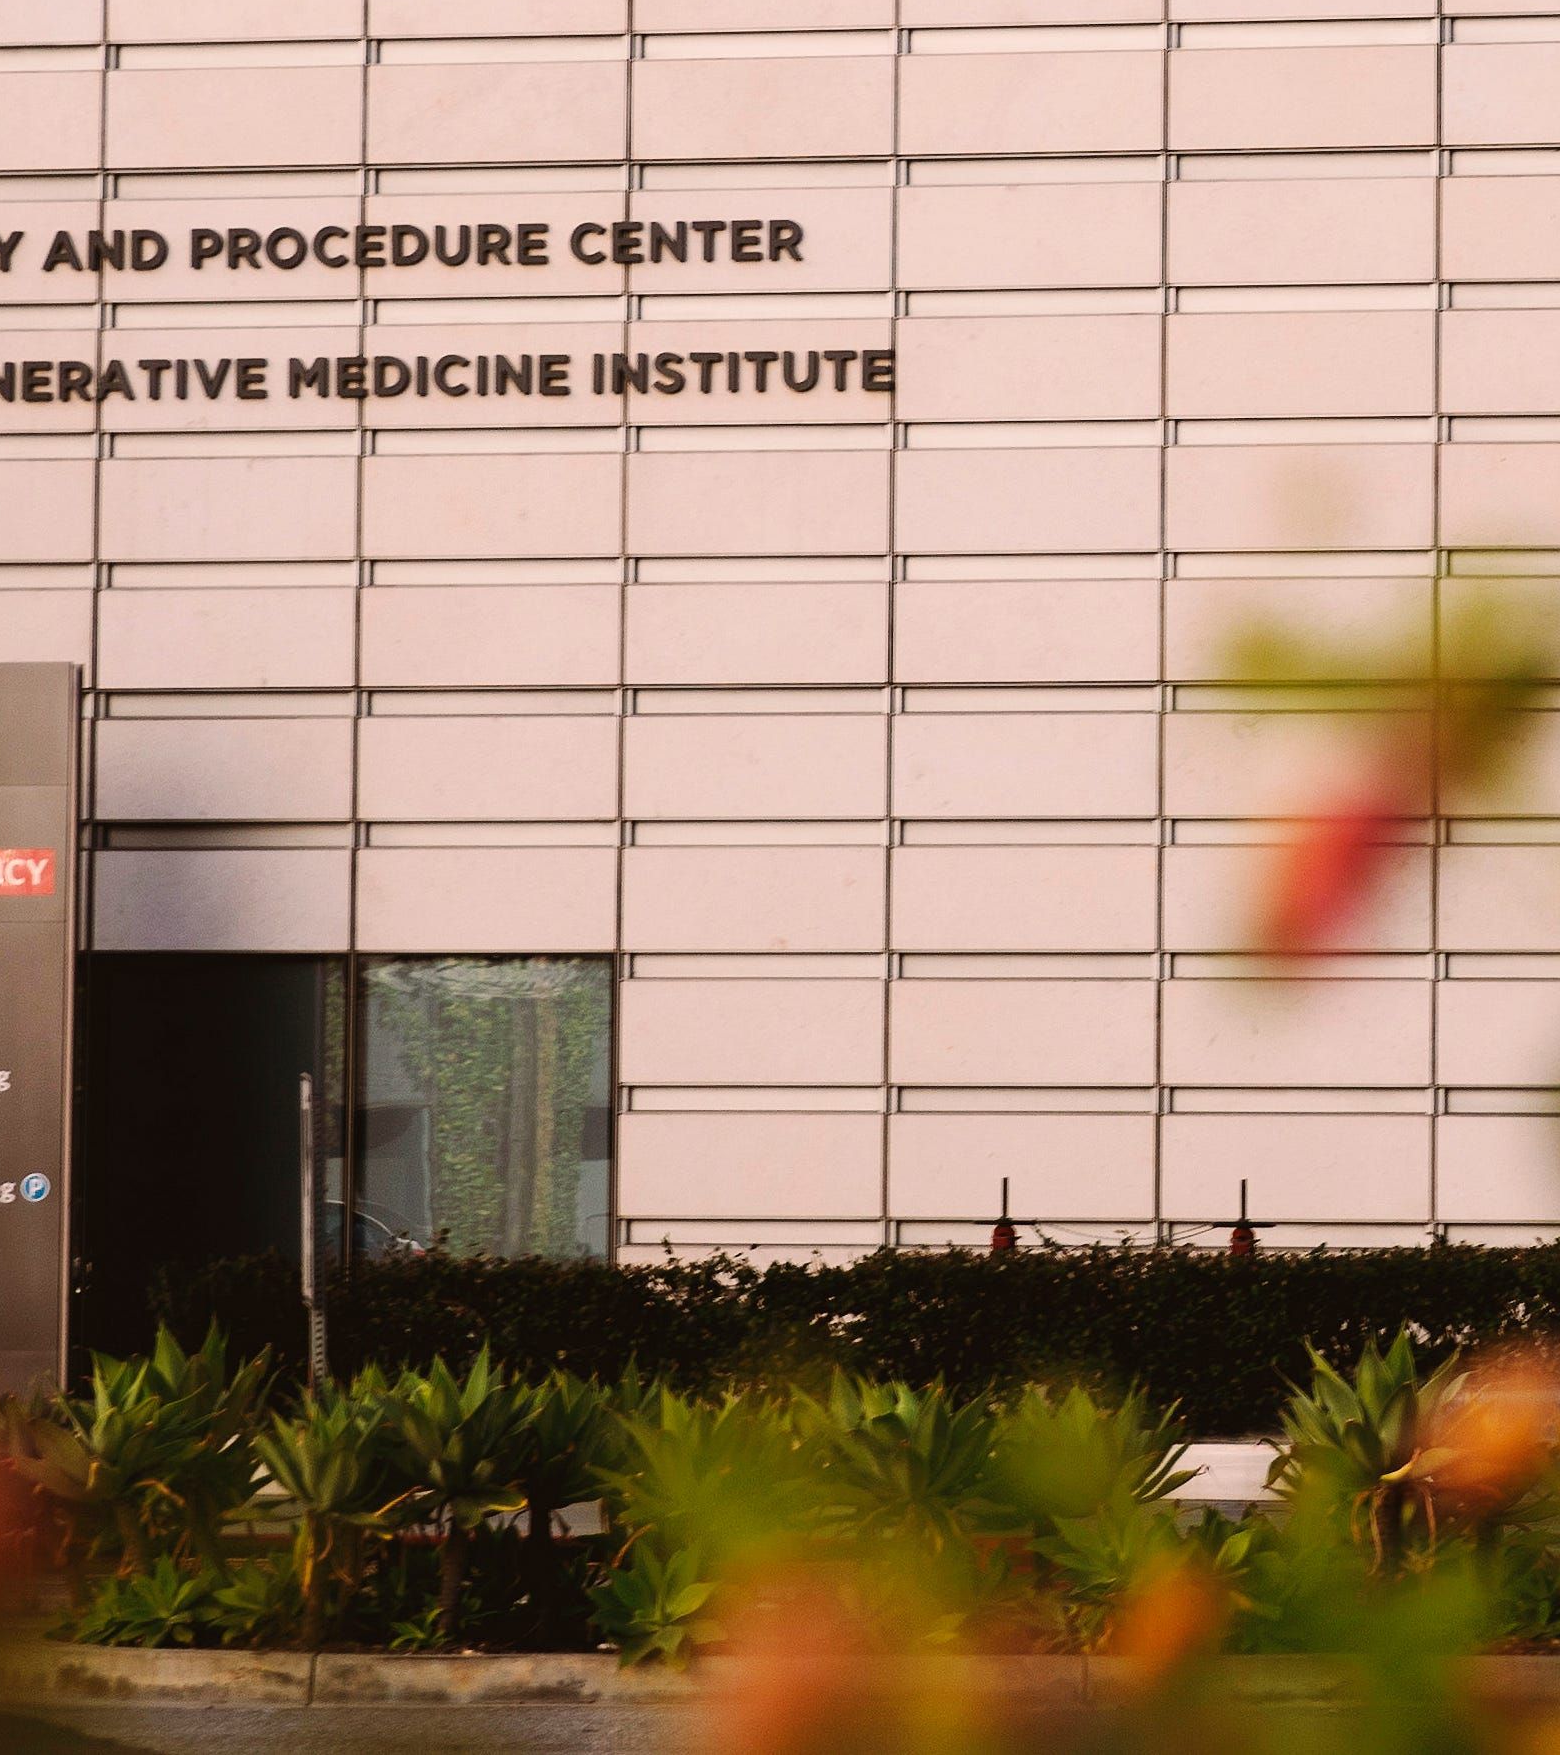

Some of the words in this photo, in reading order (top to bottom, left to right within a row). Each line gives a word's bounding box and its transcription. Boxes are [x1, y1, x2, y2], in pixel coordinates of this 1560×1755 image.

[42, 229, 169, 273] AND
[190, 223, 550, 271] PROCEDURE
[570, 219, 804, 266] CENTER
[289, 353, 570, 399] MEDICINE
[593, 349, 896, 395] INSTITUTE
